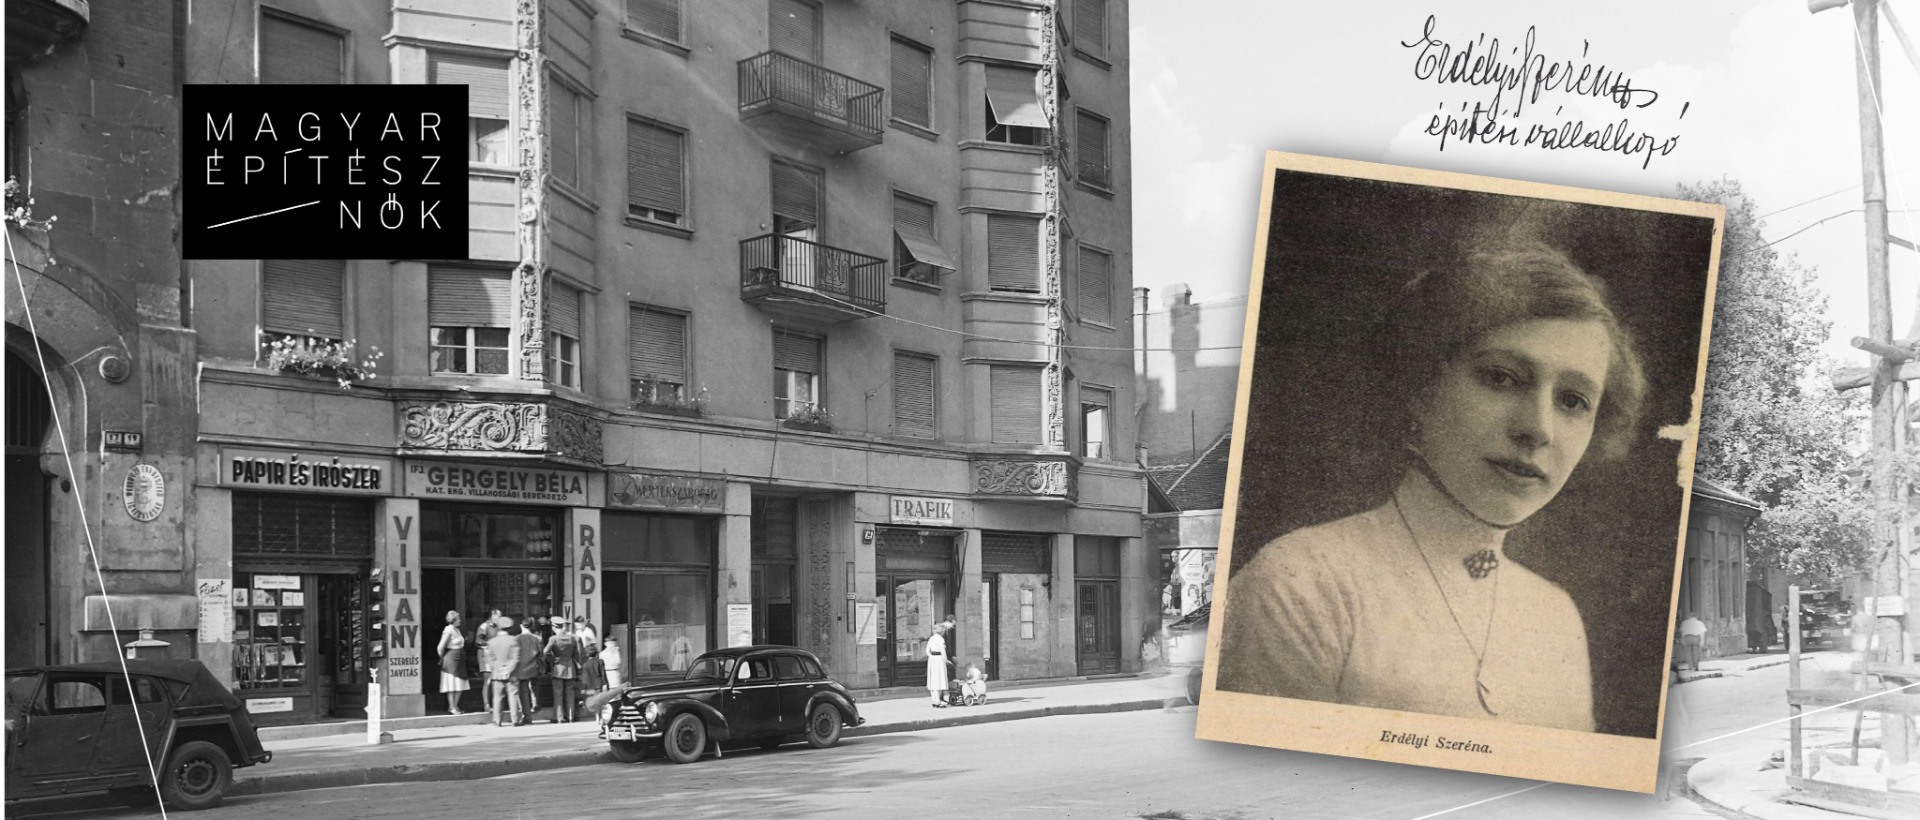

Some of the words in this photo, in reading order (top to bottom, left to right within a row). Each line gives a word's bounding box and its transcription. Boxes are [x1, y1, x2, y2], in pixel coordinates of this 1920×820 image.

[289, 453, 309, 486] ÉS
[312, 456, 382, 490] IRÓSZER
[427, 466, 529, 490] GERGELY
[535, 471, 583, 495] BÉLA
[447, 487, 466, 496] ENG.
[893, 498, 952, 519] TRAFIK
[391, 515, 418, 649] VILLANY
[389, 655, 420, 667] SZERELÉS
